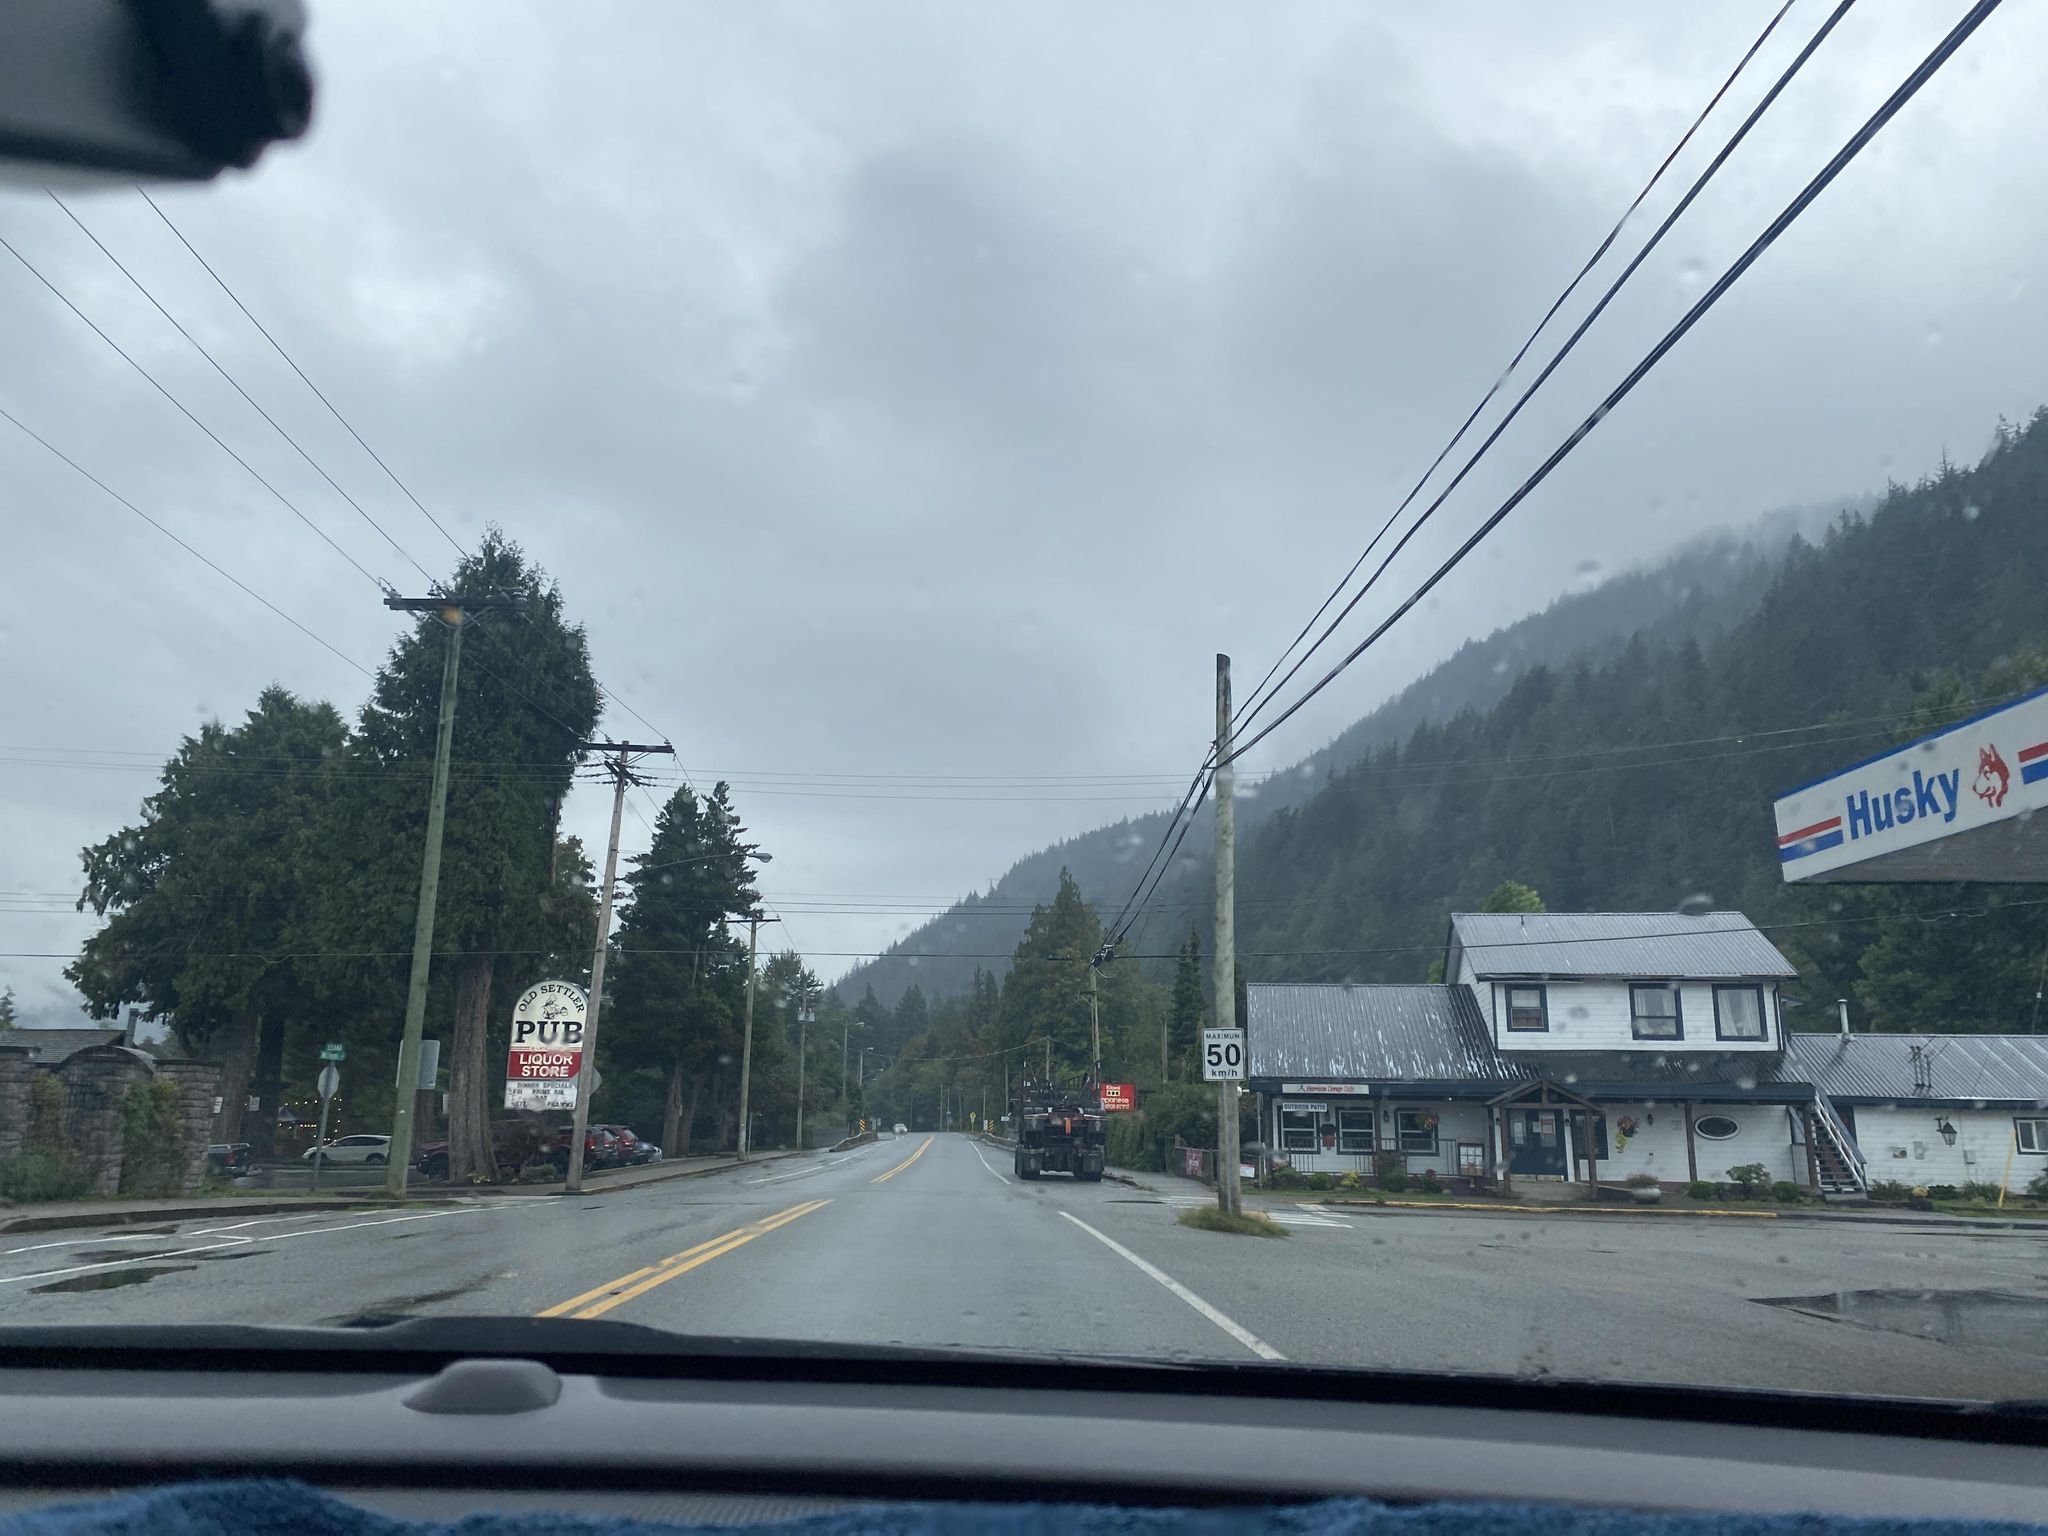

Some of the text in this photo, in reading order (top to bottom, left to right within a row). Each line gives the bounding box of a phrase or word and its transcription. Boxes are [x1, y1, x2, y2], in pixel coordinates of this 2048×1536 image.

[1846, 768, 1960, 840] Husky
[518, 984, 585, 1013] OLD SETTLER
[515, 1020, 583, 1044] PUB
[519, 1053, 573, 1066] LIQUOR
[1207, 1043, 1241, 1067] 50
[521, 1065, 569, 1077] STORE
[1211, 1068, 1238, 1077] km/h
